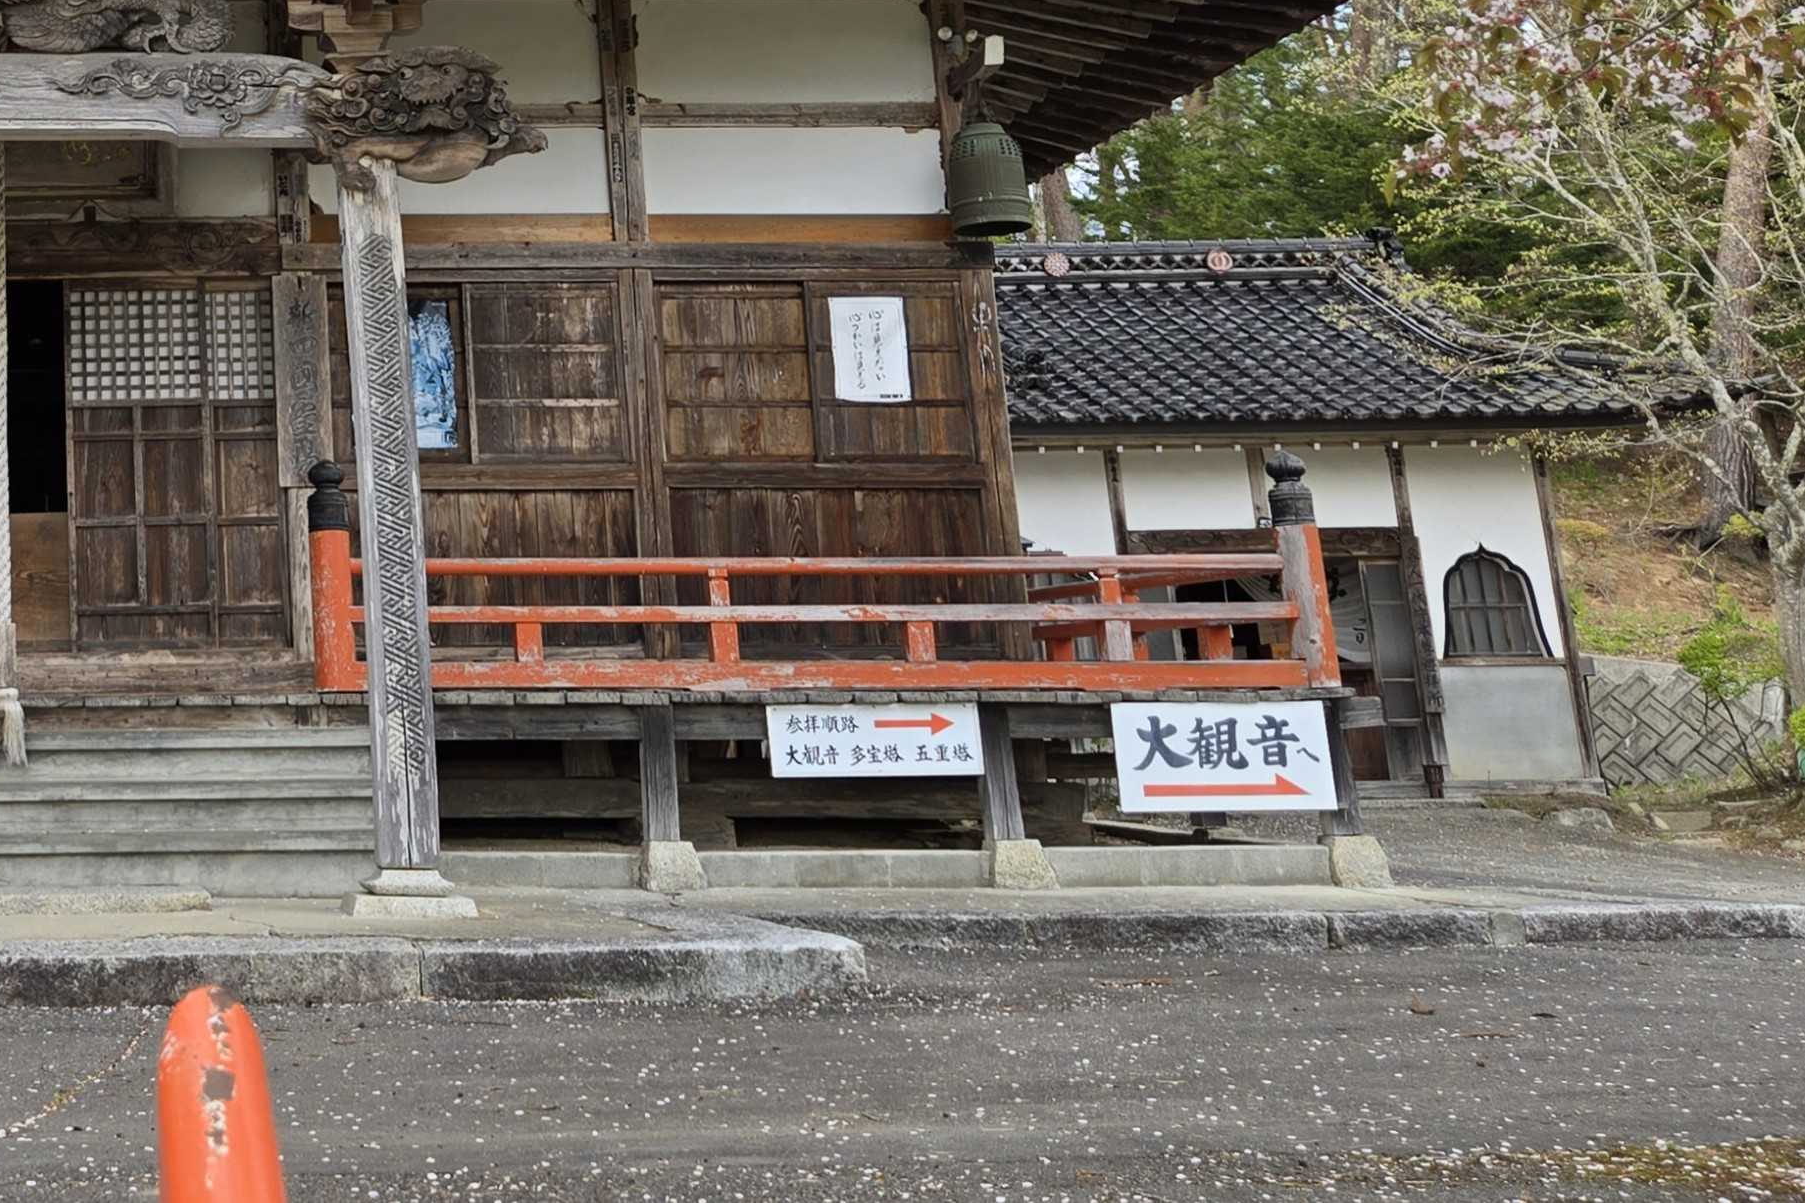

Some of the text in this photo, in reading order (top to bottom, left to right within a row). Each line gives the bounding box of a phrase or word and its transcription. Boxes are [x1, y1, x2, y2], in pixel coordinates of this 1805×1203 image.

[785, 714, 860, 734] 参拝順路
[785, 742, 974, 766] 大観音 多宝塔 五重塔
[1133, 715, 1321, 770] 大観音へ
